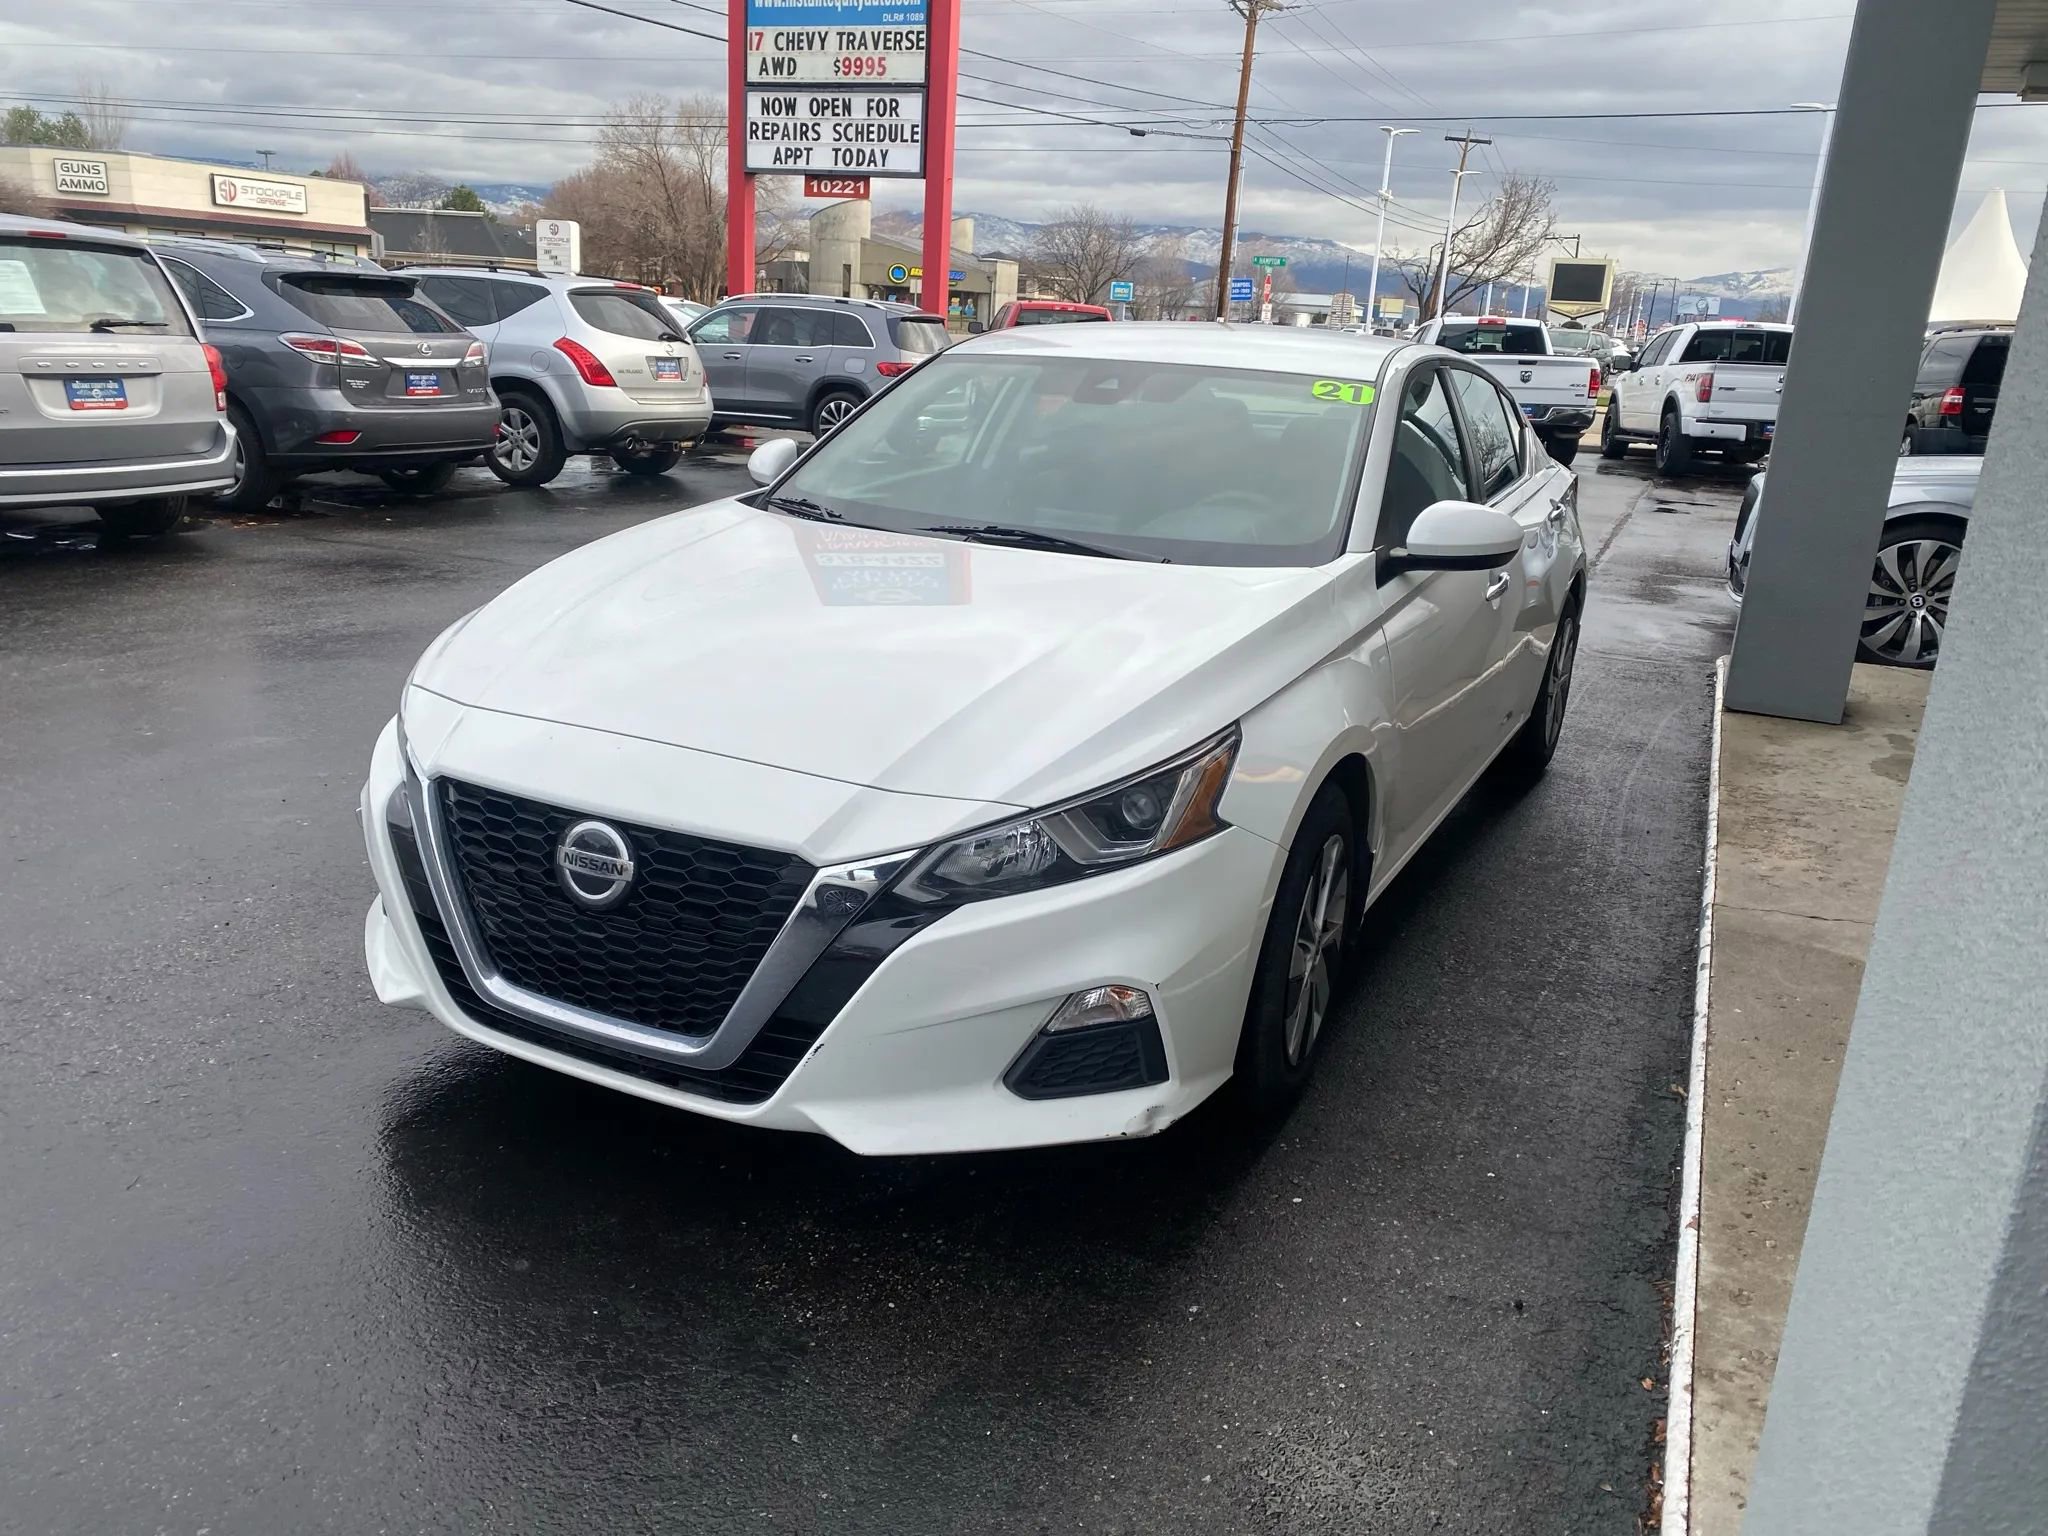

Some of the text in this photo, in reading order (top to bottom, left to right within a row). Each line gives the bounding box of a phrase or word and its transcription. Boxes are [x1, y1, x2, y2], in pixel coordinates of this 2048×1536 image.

[882, 12, 904, 22] DLR#
[749, 30, 925, 51] 17 CHEVY TRAVERSE
[759, 56, 887, 77] AWD $9995
[761, 97, 900, 118] NOW OPEN FOR
[749, 121, 920, 143] REPAIRS SCHEDULE
[772, 146, 889, 168] APPT TODAY
[60, 162, 101, 175] GUNS
[59, 178, 105, 191] AMMO
[240, 185, 303, 201] STOCKPILE
[809, 179, 865, 195] 10221
[1318, 382, 1363, 403] 21
[564, 851, 624, 876] NISSAN
